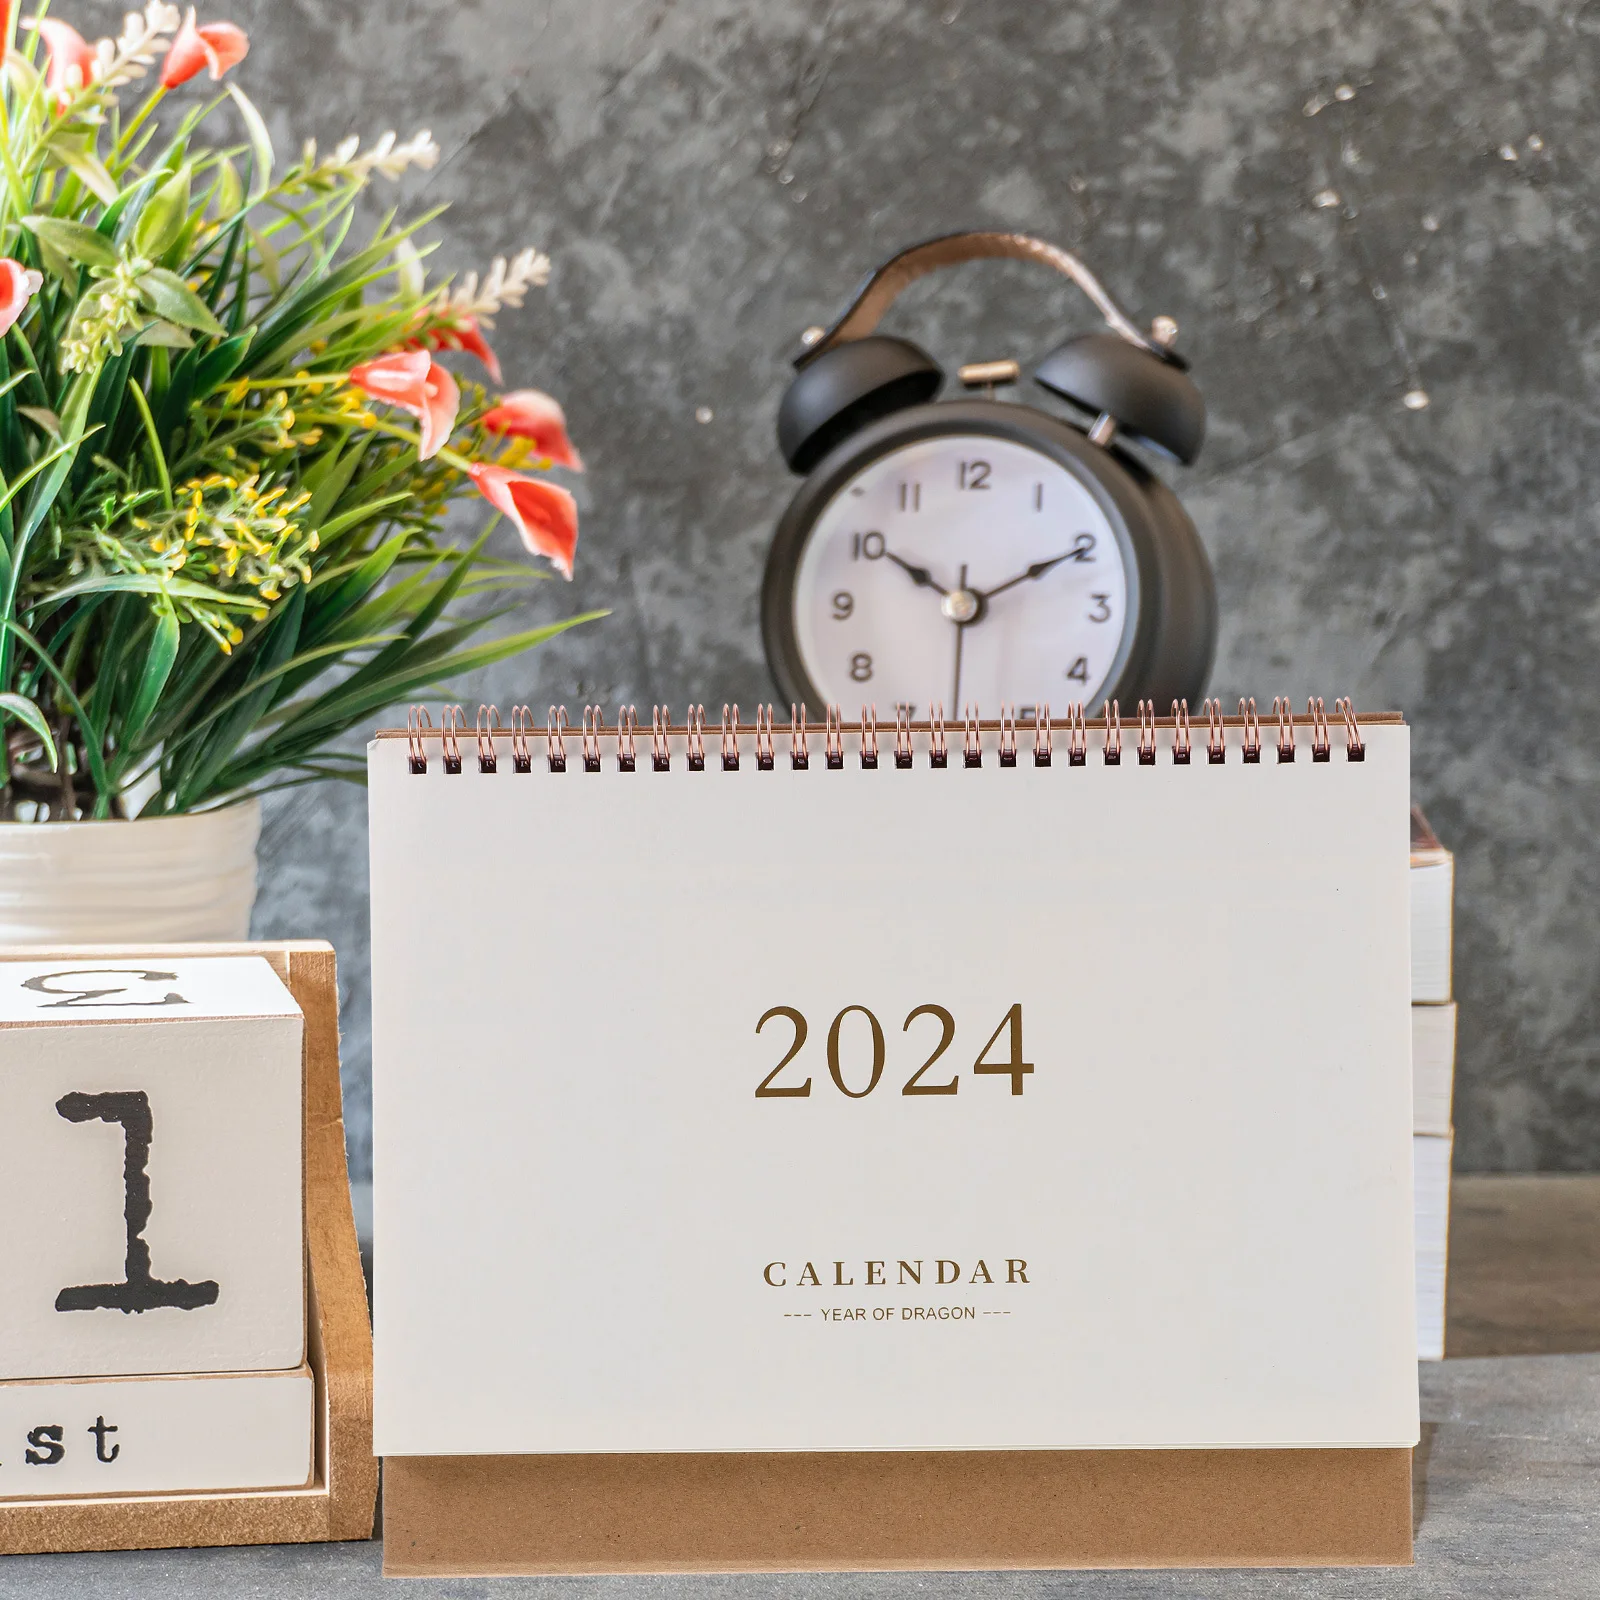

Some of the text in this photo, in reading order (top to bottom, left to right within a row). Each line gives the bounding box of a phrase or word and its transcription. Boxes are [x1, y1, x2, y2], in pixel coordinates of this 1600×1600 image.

[958, 460, 992, 490] 12
[900, 482, 921, 513] 11
[1034, 481, 1044, 513] 1
[851, 531, 888, 561] 10
[1074, 533, 1097, 563] 2
[832, 591, 854, 621] 9
[1088, 593, 1111, 624] 3
[849, 652, 874, 683] 8
[1064, 656, 1089, 684] 4
[754, 1003, 1035, 1099] 2024
[54, 1090, 220, 1315] 1
[763, 1258, 1031, 1287] CALENDAR
[820, 1308, 867, 1322] YEAR
[872, 1307, 895, 1321] OF
[901, 1306, 976, 1321] DRAGON
[0, 1415, 120, 1466] st
